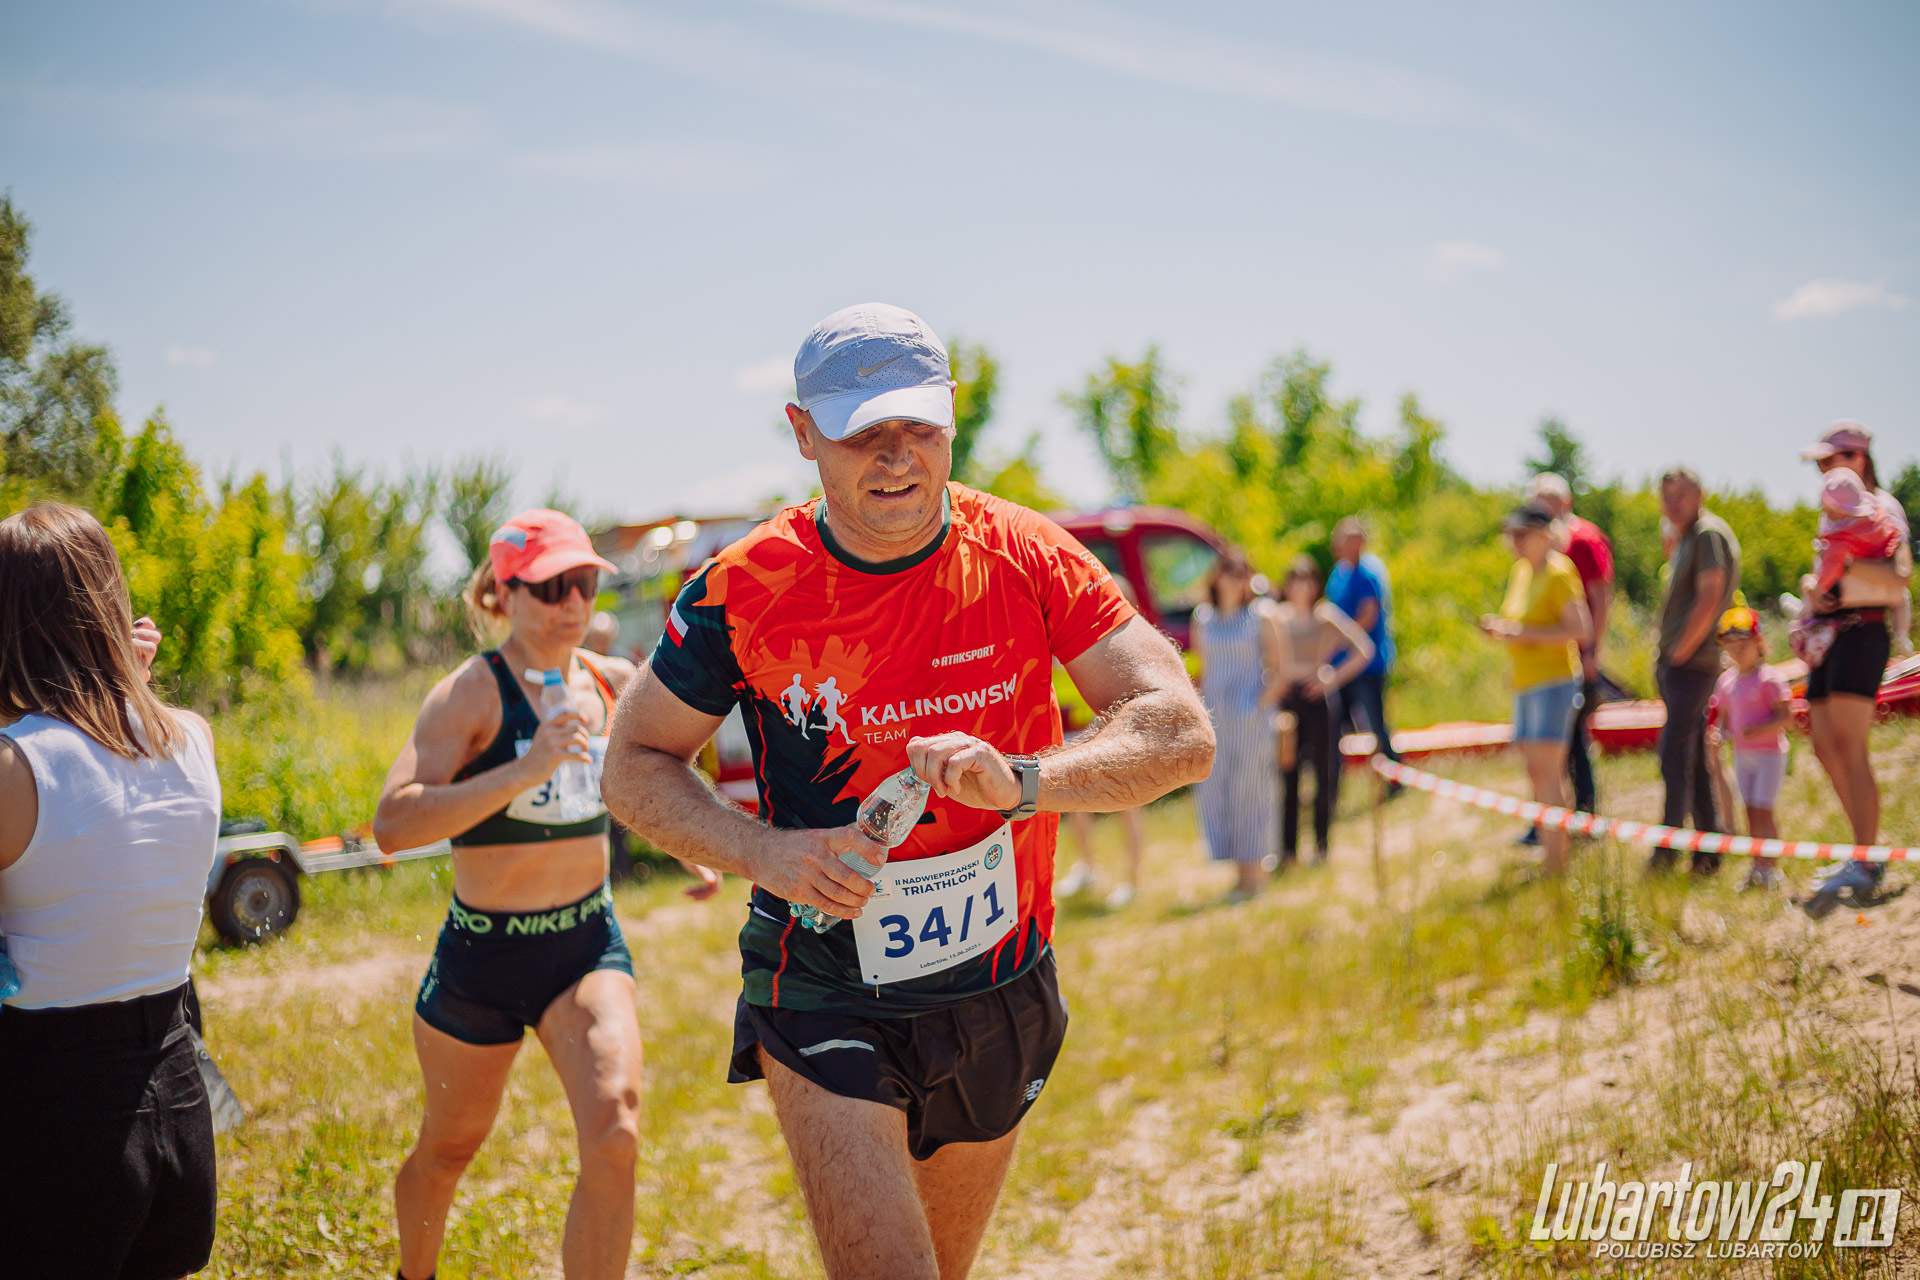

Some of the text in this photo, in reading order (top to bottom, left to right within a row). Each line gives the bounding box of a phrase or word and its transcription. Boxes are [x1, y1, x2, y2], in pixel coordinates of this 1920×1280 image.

[941, 644, 995, 667] ATAKSPORT
[864, 728, 907, 744] TEAM
[902, 870, 977, 896] TRIATHLON
[505, 907, 577, 935] NIKE
[879, 881, 1005, 959] 34/1
